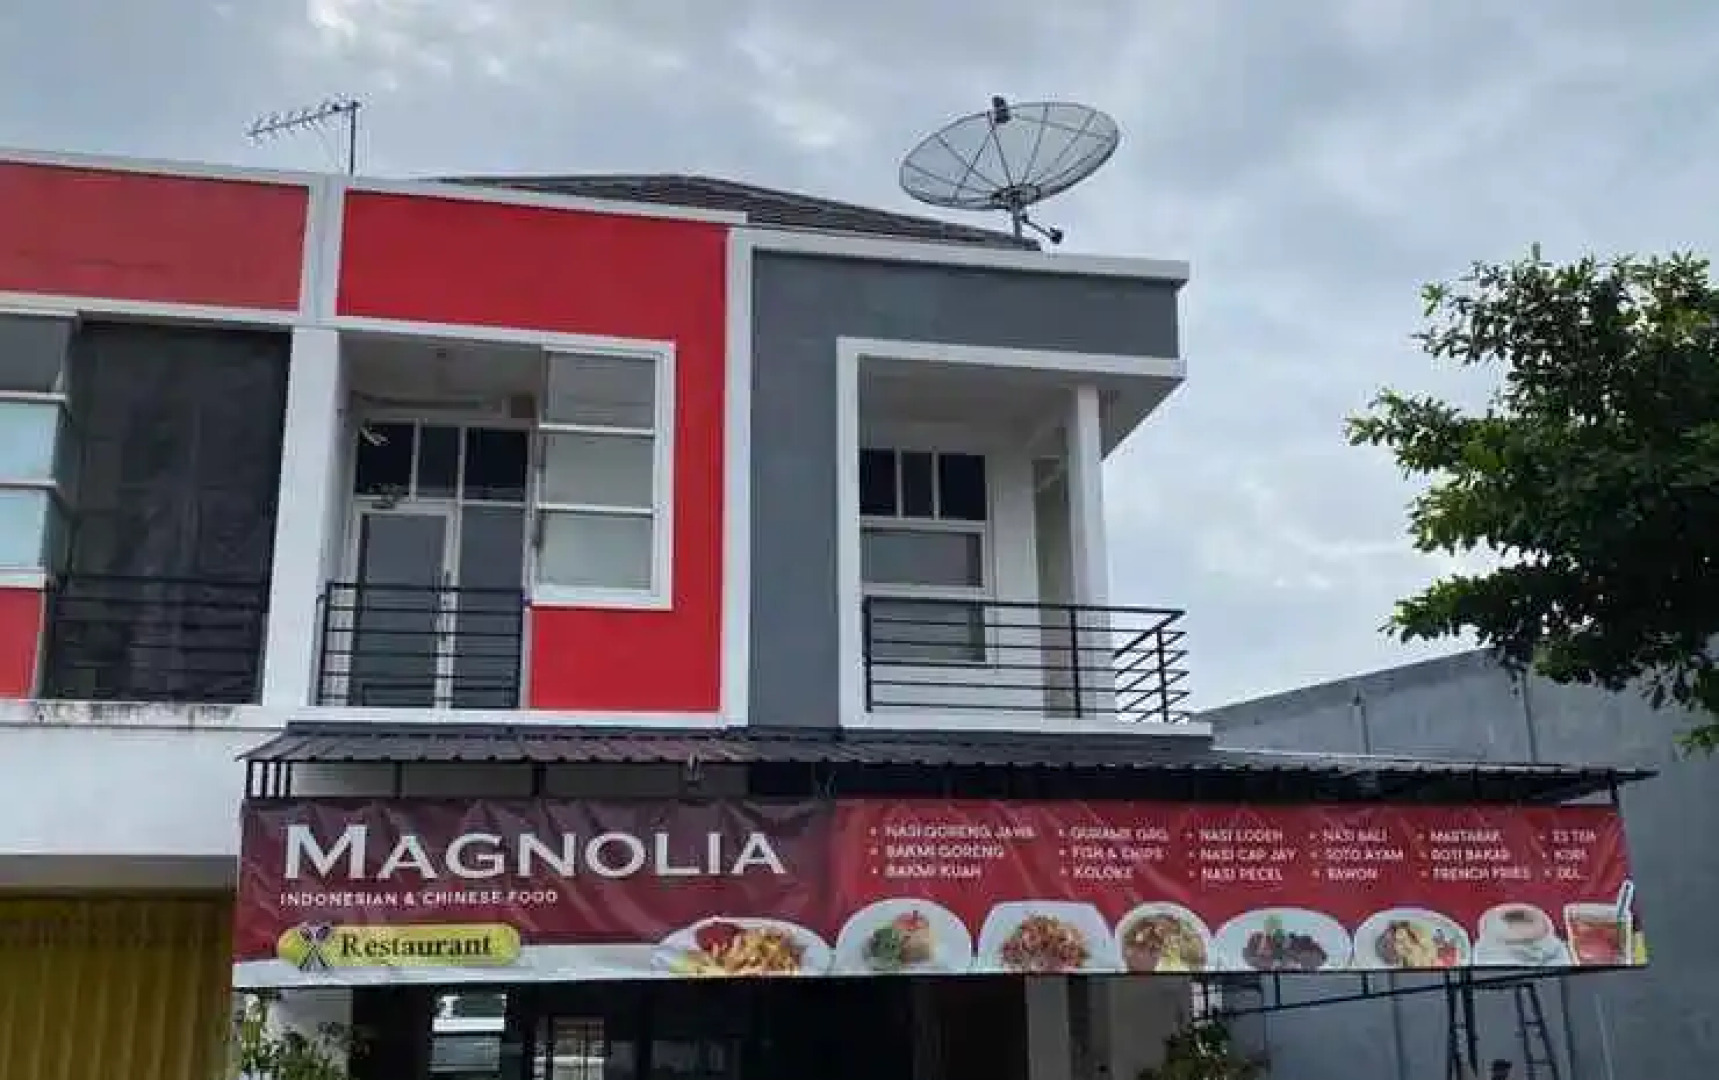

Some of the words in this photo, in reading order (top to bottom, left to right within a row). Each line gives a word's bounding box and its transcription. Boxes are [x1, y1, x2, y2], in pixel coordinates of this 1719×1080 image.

[285, 824, 786, 880] MAGNOLIA
[280, 891, 398, 908] INDONESIAN
[404, 892, 416, 907] &
[422, 890, 500, 906] CHINESE
[507, 889, 559, 905] FOOD
[340, 928, 494, 959] Restaurant
